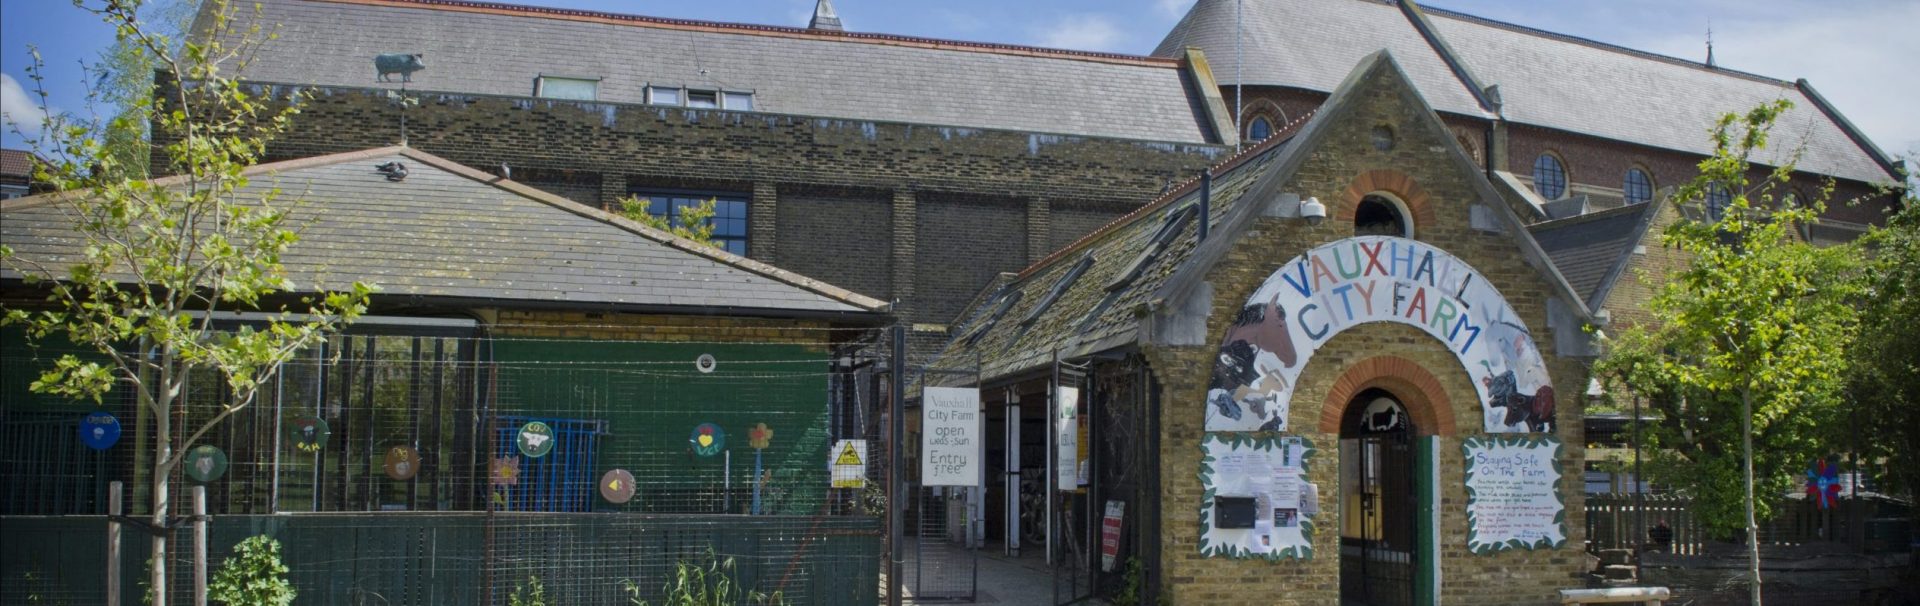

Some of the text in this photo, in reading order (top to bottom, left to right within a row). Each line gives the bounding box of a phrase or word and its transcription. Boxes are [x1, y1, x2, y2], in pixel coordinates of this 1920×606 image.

[1282, 240, 1472, 310] VAUXHALL
[1297, 279, 1481, 355] CITY FARM
[931, 395, 972, 409] Vauxhall
[928, 409, 974, 422] City Farm
[935, 426, 965, 438] open
[297, 441, 321, 453] BAH
[930, 450, 967, 467] Entry
[1476, 452, 1539, 469] Staying Safe
[933, 464, 961, 476] free
[1481, 467, 1495, 476] On
[1522, 468, 1547, 478] Farm
